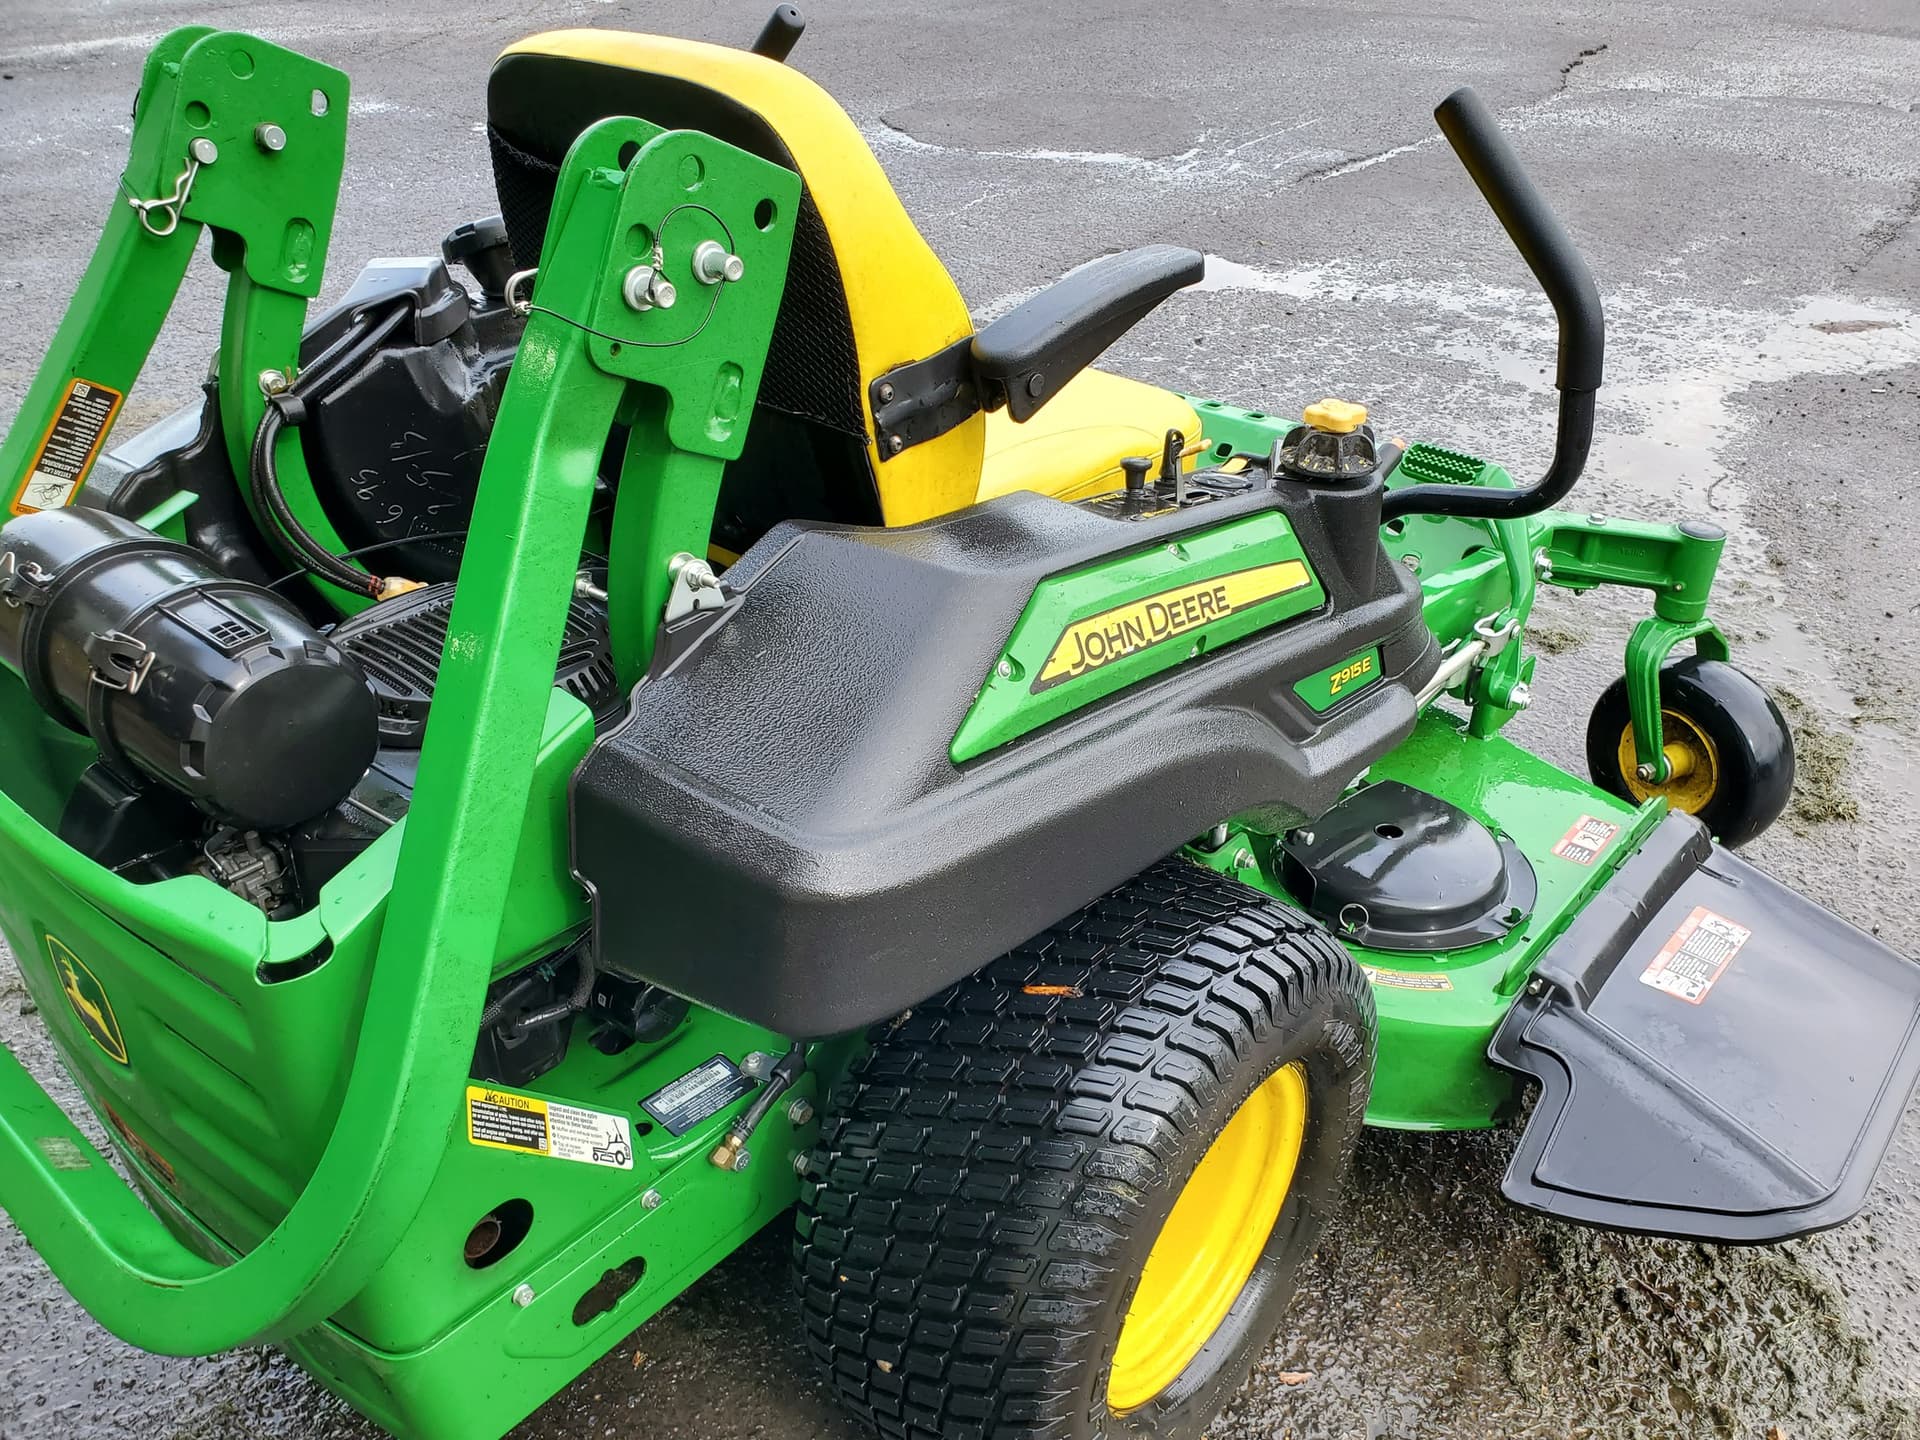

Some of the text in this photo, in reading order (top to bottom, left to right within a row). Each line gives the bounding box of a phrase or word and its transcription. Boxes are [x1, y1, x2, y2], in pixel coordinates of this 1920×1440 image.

[1071, 585, 1231, 670] JOHN DEERE
[1330, 656, 1372, 696] Z915E
[493, 1094, 530, 1109] CAUTION
